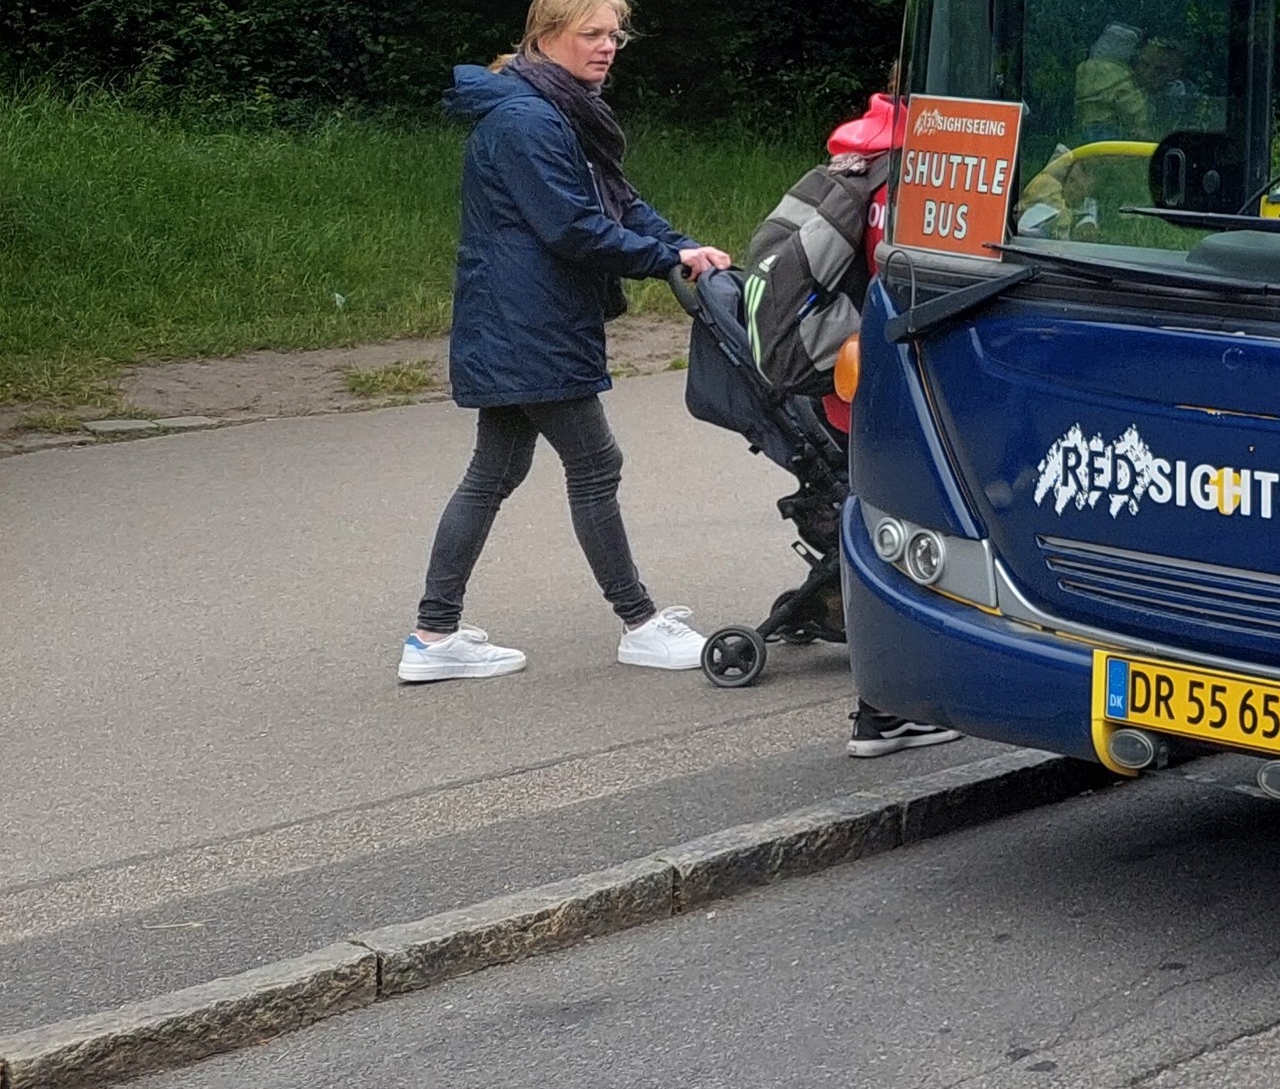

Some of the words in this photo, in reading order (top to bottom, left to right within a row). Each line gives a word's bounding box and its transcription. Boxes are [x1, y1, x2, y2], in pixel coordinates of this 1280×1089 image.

[904, 150, 1008, 195] SHUTTLE
[922, 199, 969, 240] BUS
[1109, 693, 1124, 710] DK
[1130, 670, 1176, 721] DR
[1186, 679, 1228, 730] 55
